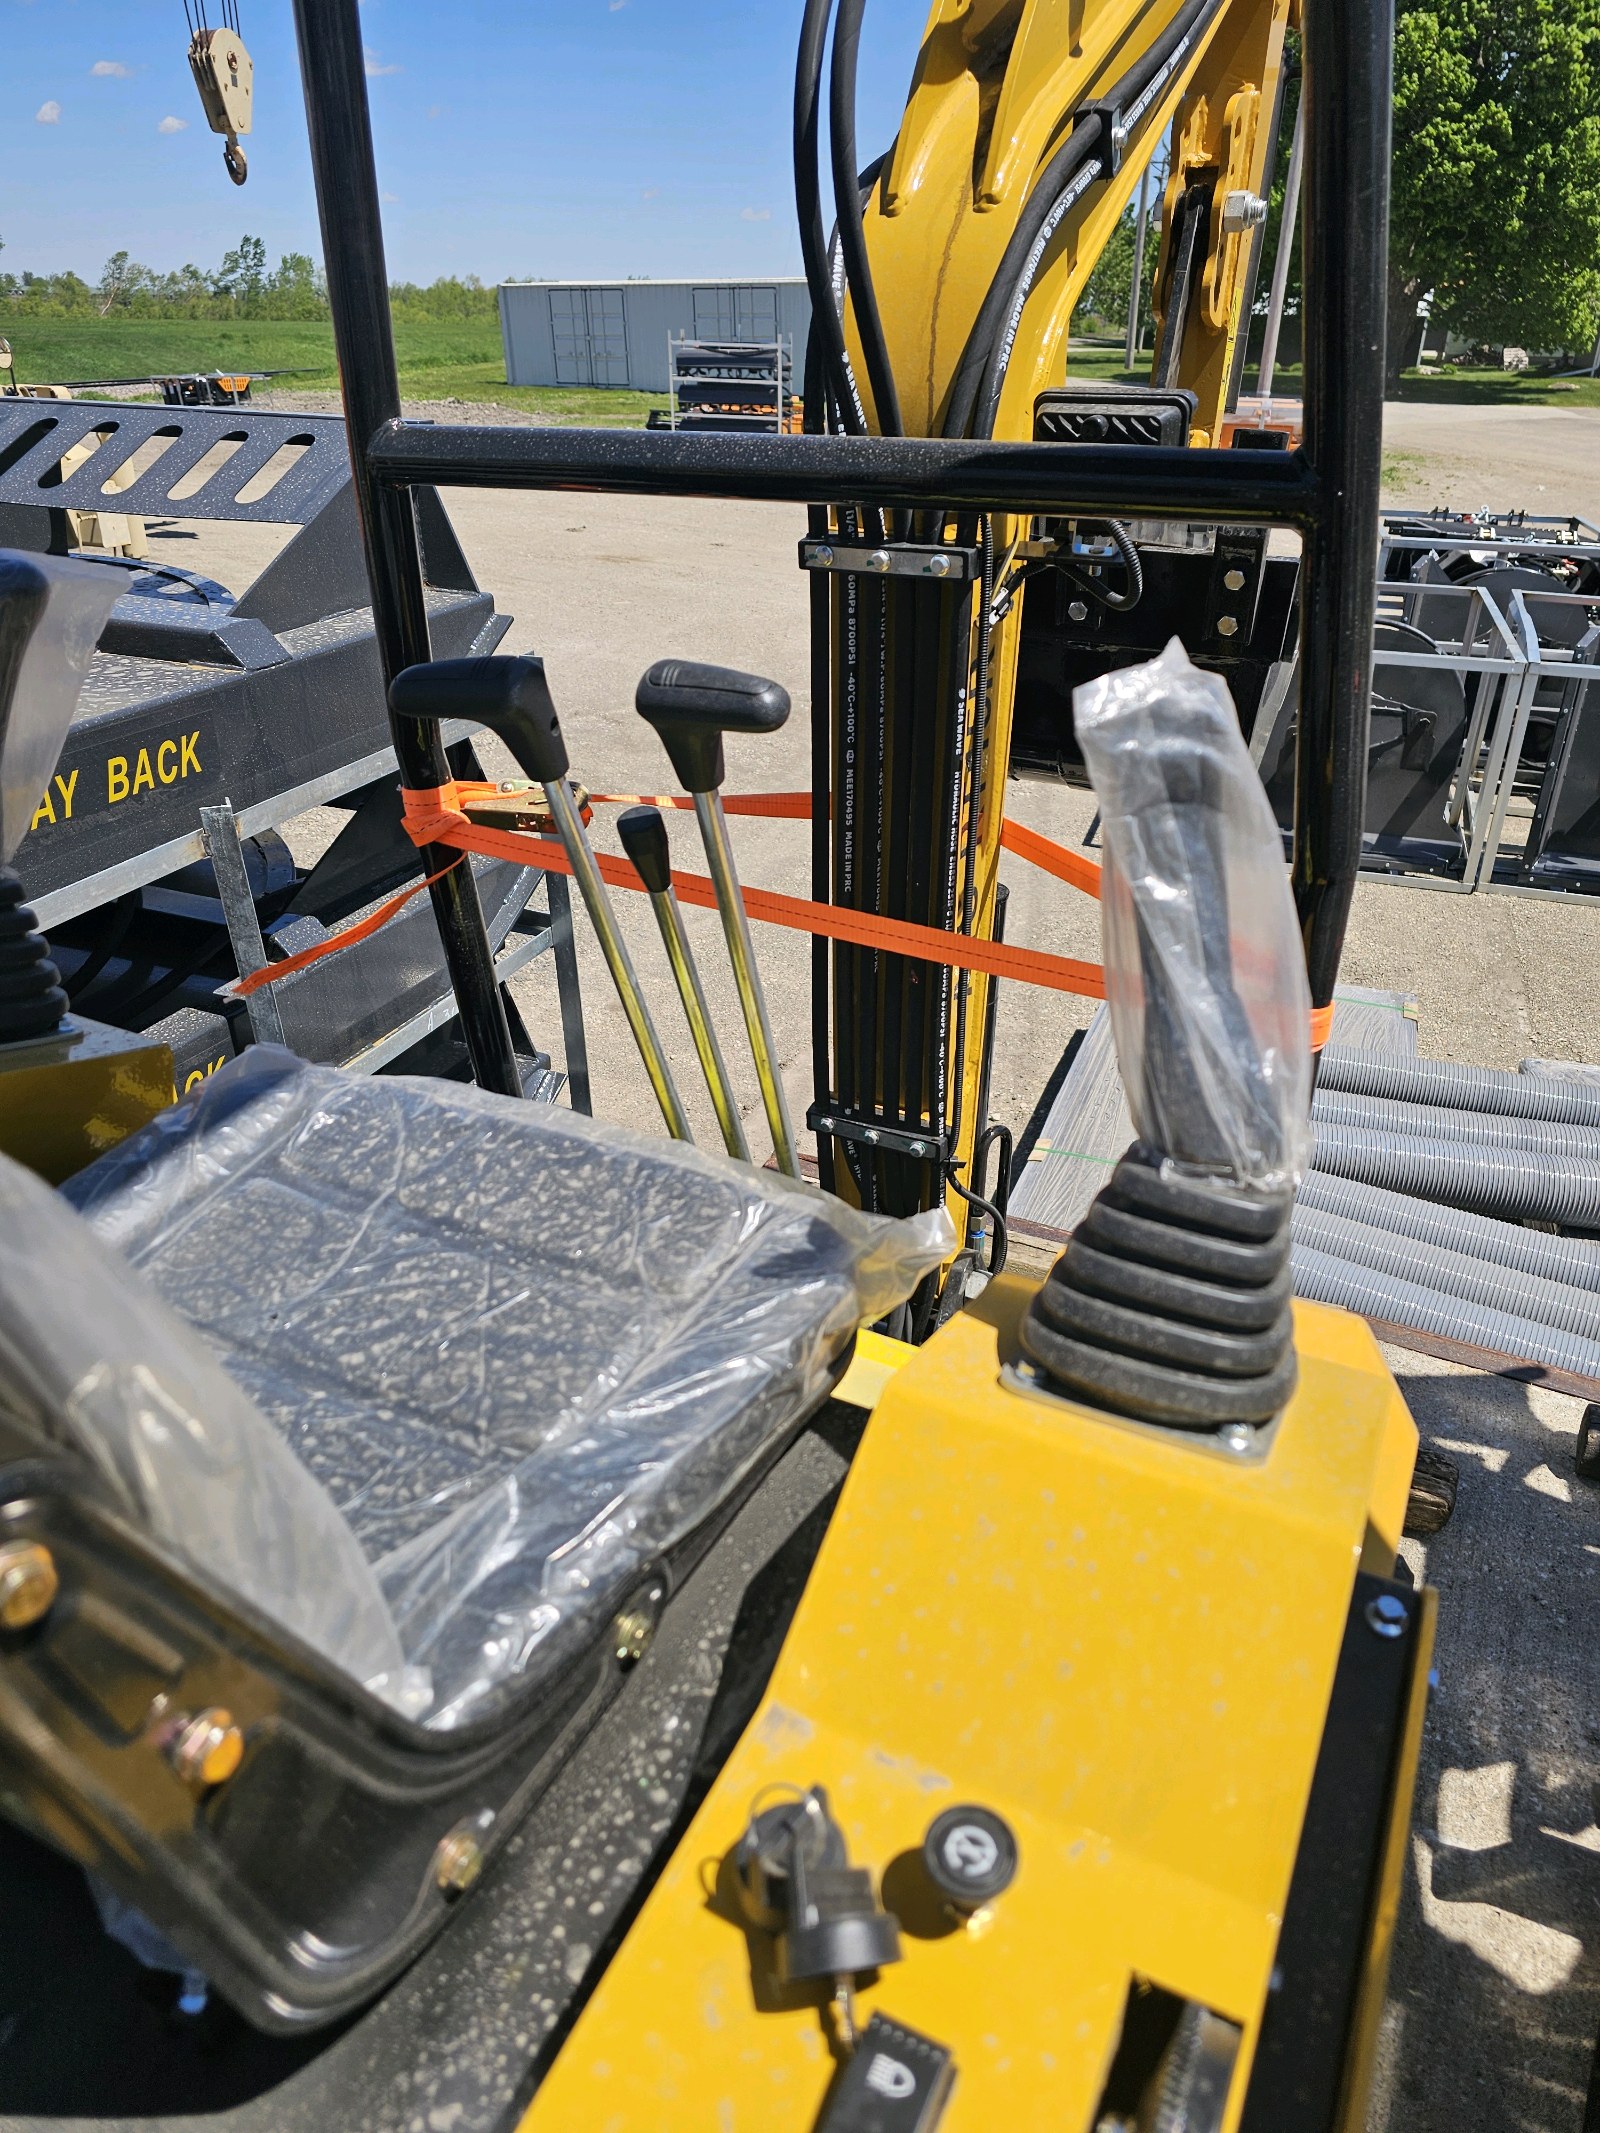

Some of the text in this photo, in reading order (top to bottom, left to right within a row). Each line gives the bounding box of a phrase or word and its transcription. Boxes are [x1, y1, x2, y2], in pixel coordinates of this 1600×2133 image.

[1012, 293, 1025, 331] MADE
[1006, 330, 1015, 344] IN
[999, 344, 1012, 372] PRC
[848, 618, 856, 664] 8700PSI
[30, 730, 203, 831] AY BACK
[846, 769, 854, 825] MEE170495
[951, 772, 960, 825] HYDRAULIC
[845, 831, 853, 860] MADE
[949, 827, 958, 852] HOSE
[845, 861, 852, 872] IN
[844, 873, 852, 892] PRC
